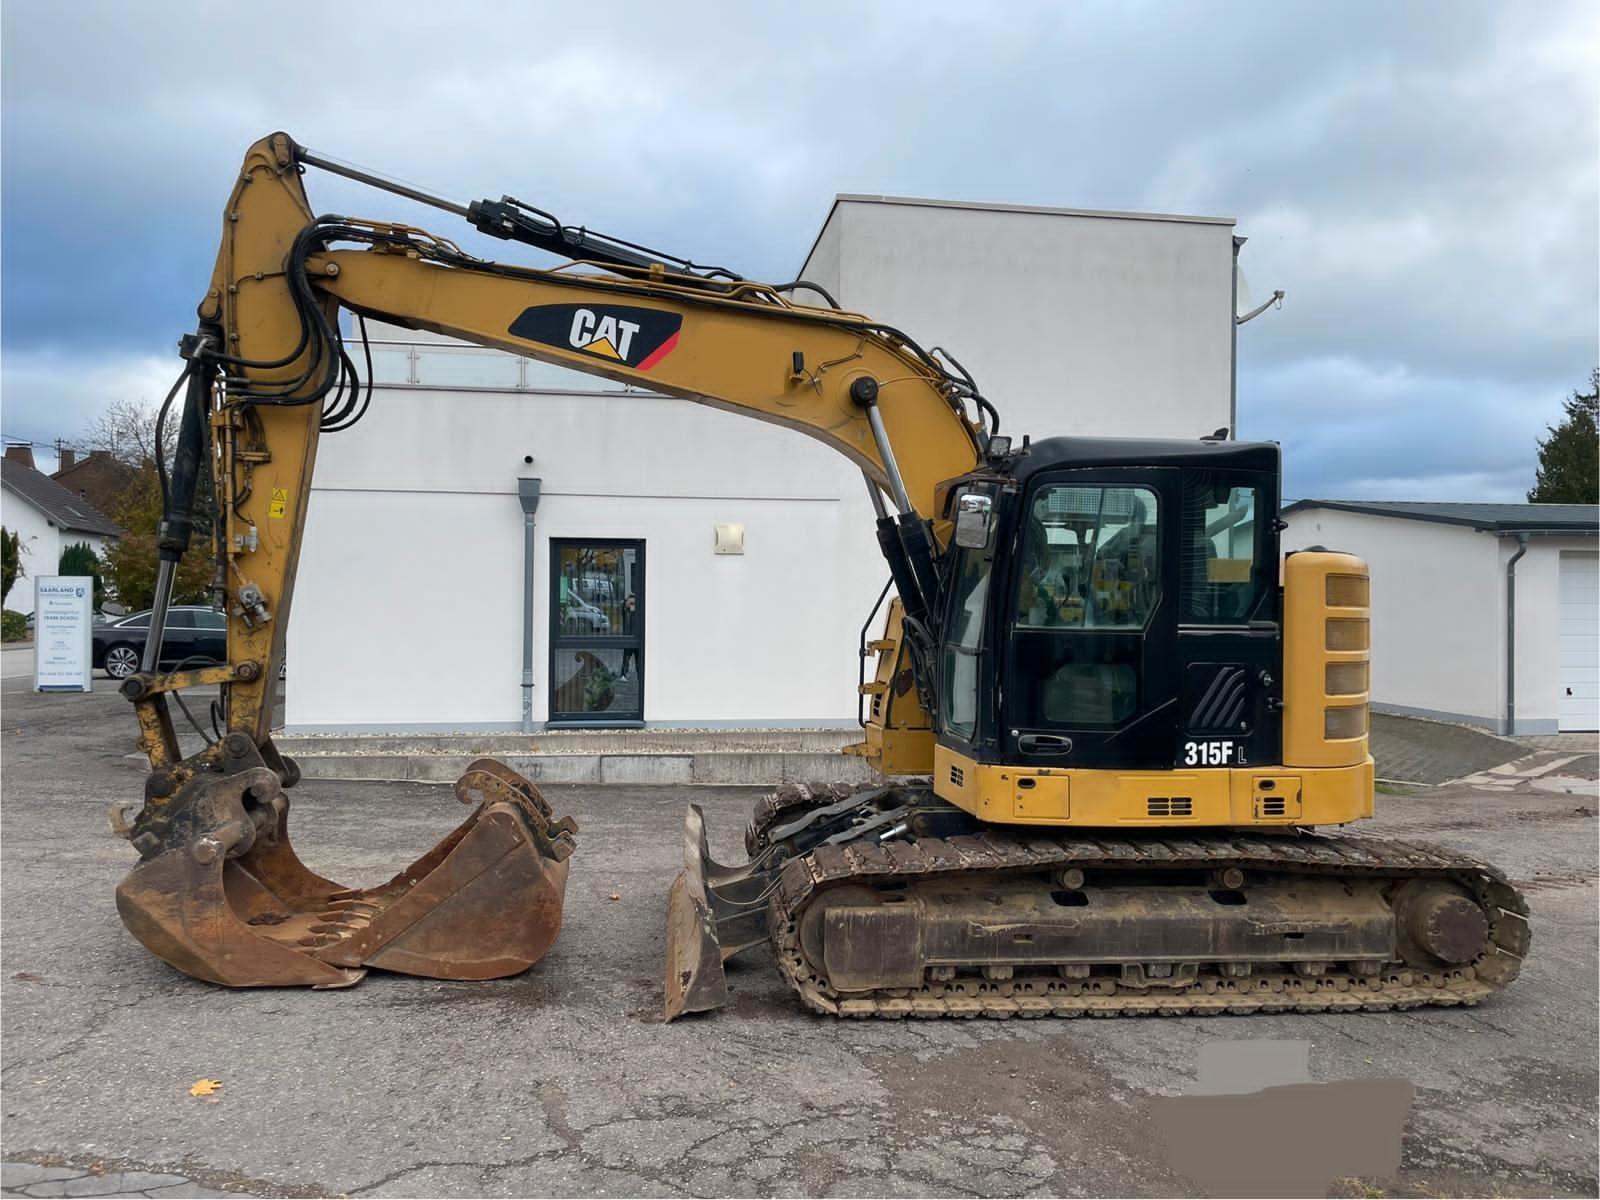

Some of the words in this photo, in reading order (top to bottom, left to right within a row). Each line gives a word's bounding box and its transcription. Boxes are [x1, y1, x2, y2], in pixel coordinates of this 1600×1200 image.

[569, 308, 640, 360] CAT
[1184, 741, 1233, 766] 315F
[1238, 745, 1248, 764] L
